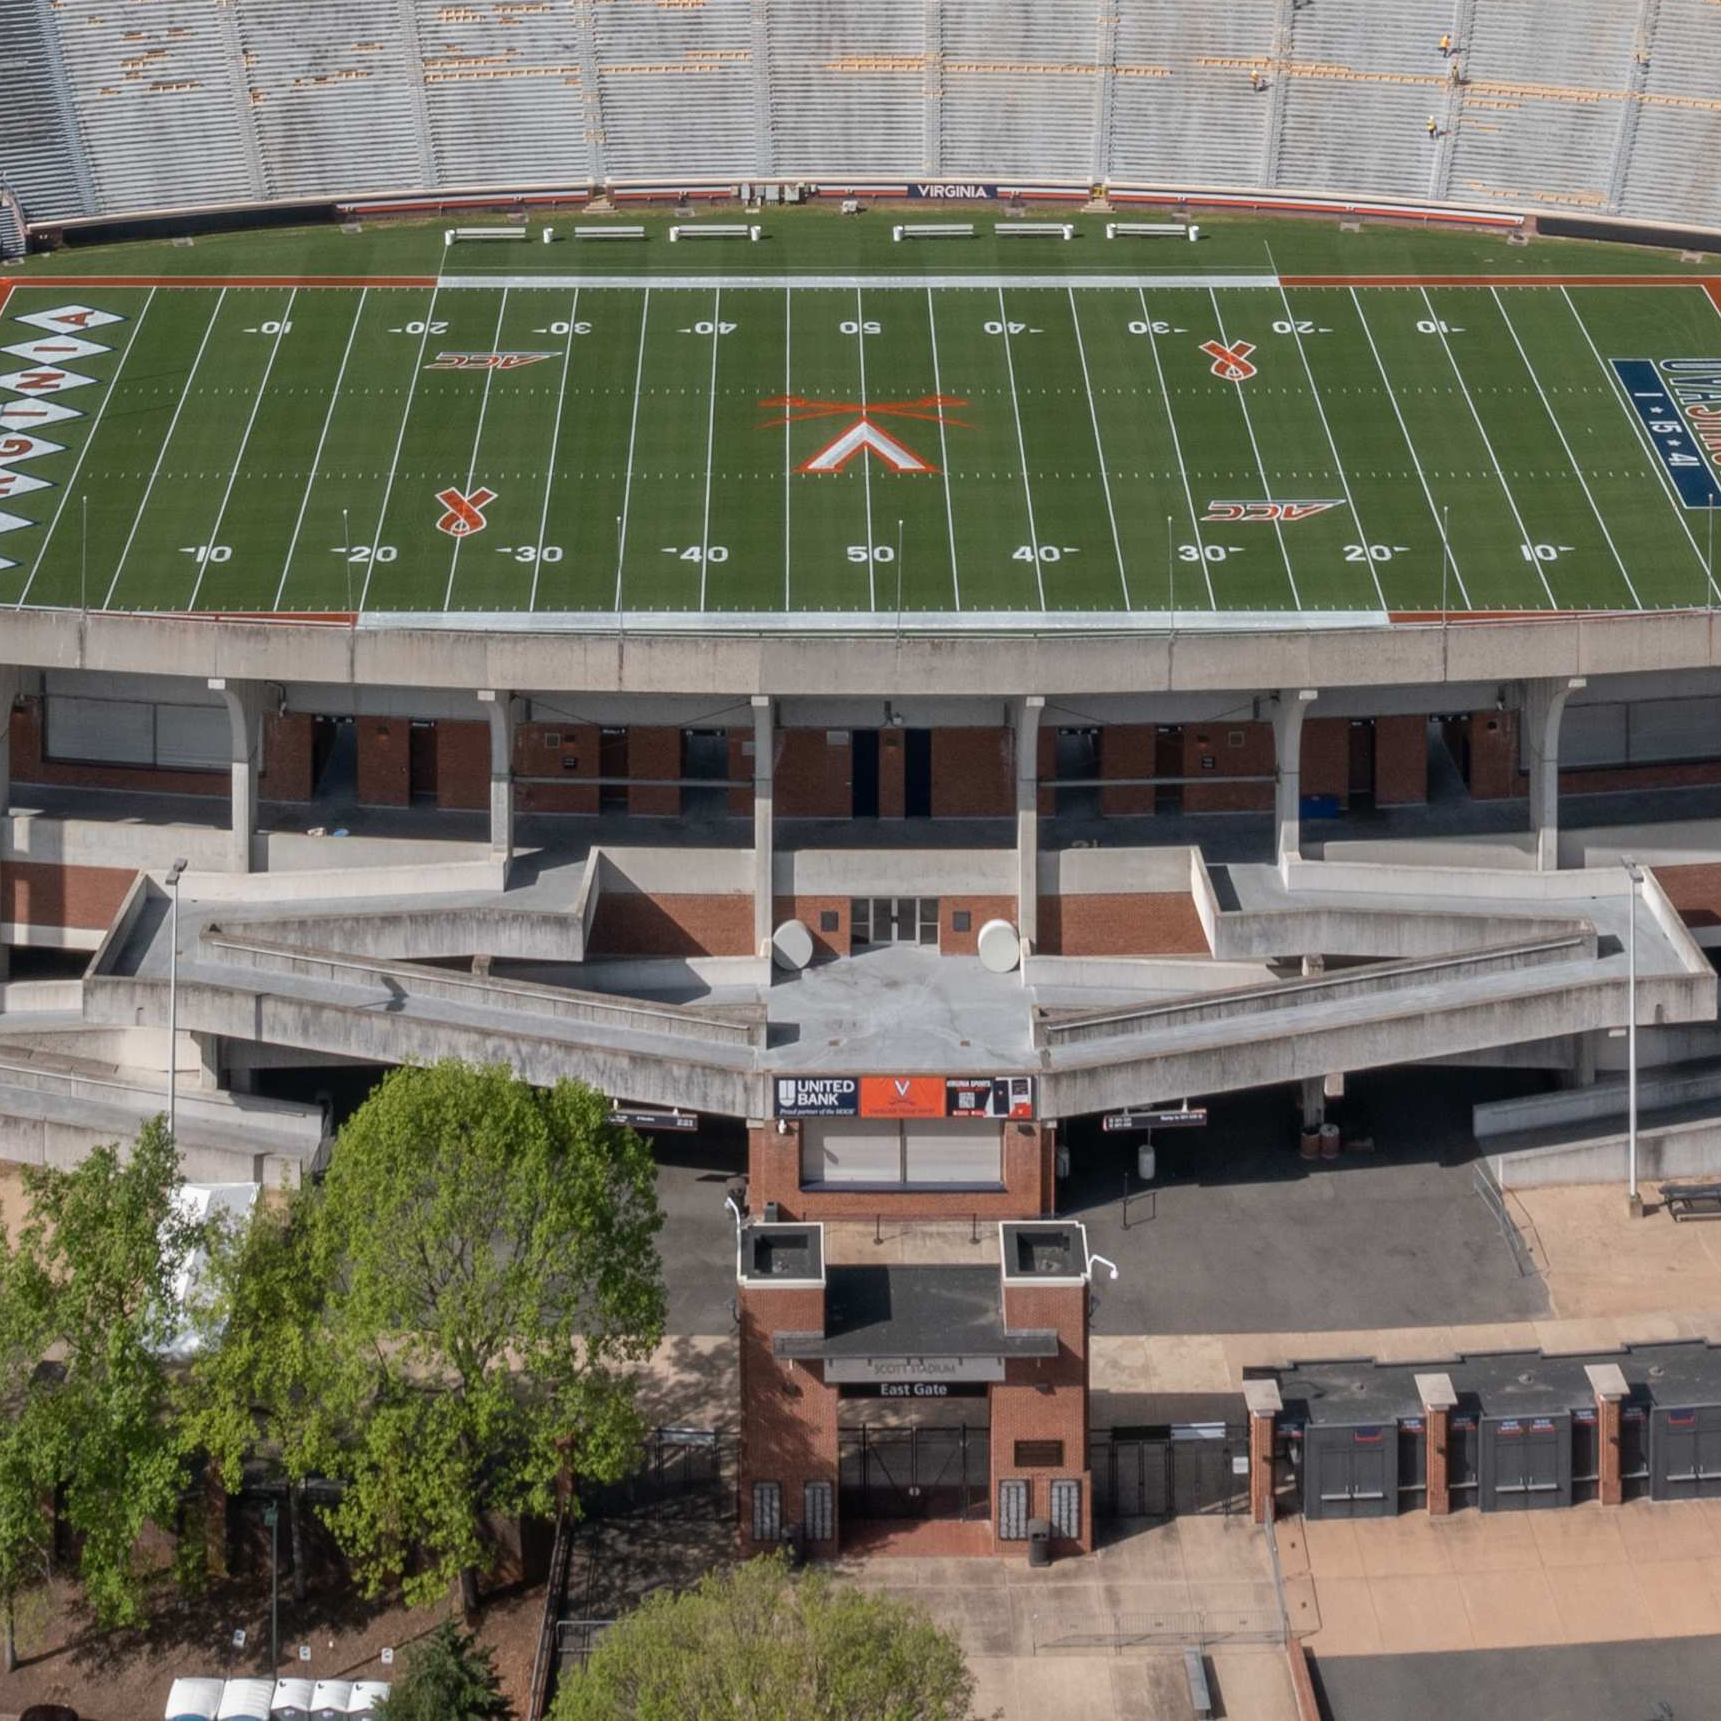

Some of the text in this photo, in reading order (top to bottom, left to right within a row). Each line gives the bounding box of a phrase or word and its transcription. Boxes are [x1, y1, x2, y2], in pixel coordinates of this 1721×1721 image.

[917, 184, 988, 198] VIRGINIA
[262, 321, 291, 335] 10
[406, 321, 448, 335] 20
[550, 321, 592, 335] 30
[694, 321, 737, 335] 40
[839, 321, 881, 335] 50
[984, 321, 1026, 335] 40
[1128, 321, 1170, 335] 30
[1272, 321, 1314, 335] 20
[1417, 321, 1448, 335] 10
[423, 351, 563, 370] ACC
[1648, 420, 1683, 434] 15
[1668, 452, 1701, 467] 41
[1201, 499, 1347, 522] ACC
[195, 545, 233, 563] 10
[349, 545, 398, 563] 20
[515, 545, 563, 563] 30
[680, 545, 729, 563] 40
[847, 545, 895, 563] 50
[1012, 545, 1061, 563] 40
[1179, 545, 1227, 563] 30
[1344, 545, 1392, 563] 20
[1521, 545, 1558, 563] 10
[797, 1079, 855, 1093] UNITED
[797, 1093, 839, 1106] BANK
[874, 1364, 956, 1375] SCOTT STADIUM
[881, 1383, 948, 1396] East Gate
